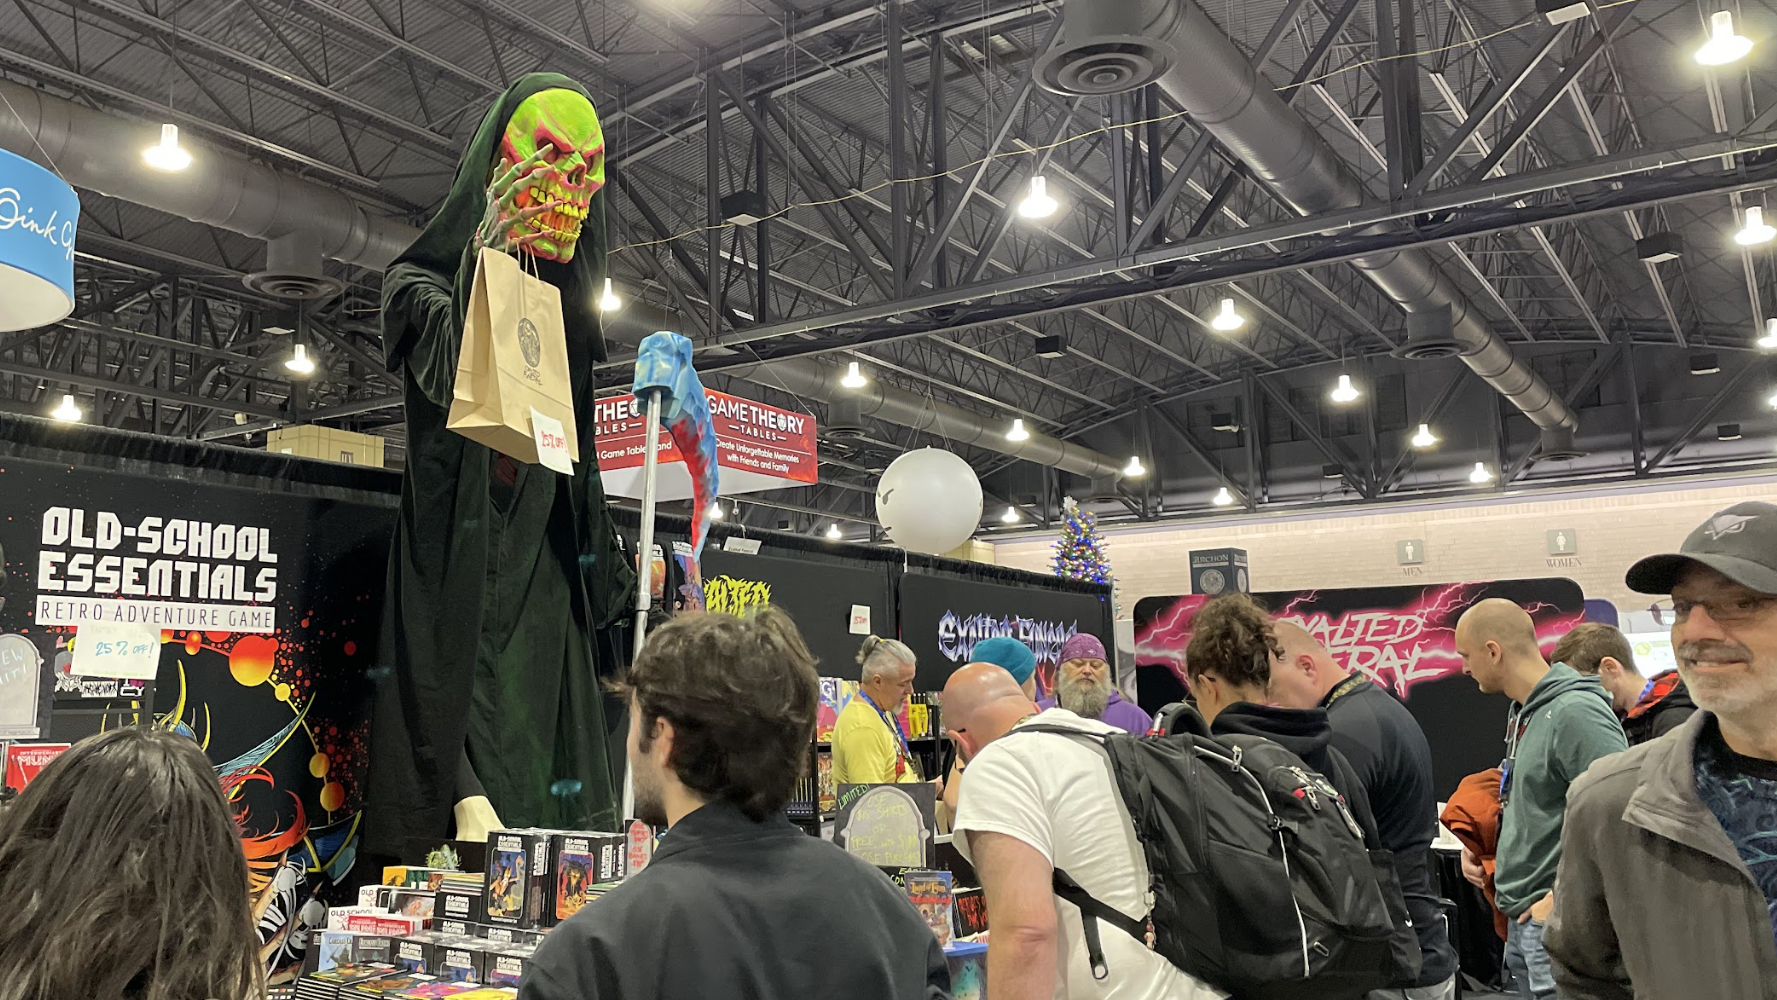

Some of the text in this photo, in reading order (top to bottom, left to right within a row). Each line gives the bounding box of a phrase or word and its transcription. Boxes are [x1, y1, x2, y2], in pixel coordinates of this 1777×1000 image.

[740, 424, 776, 441] TABLES
[601, 449, 625, 459] Game
[626, 444, 646, 456] Table
[41, 506, 278, 563] OLD-SCHOOL
[1546, 557, 1582, 568] WOMEN
[38, 550, 277, 602] ESSENTIALS
[1402, 566, 1423, 577] MEN
[41, 601, 272, 628] RETRO ADVENTURE GAME
[95, 641, 129, 656] 25%
